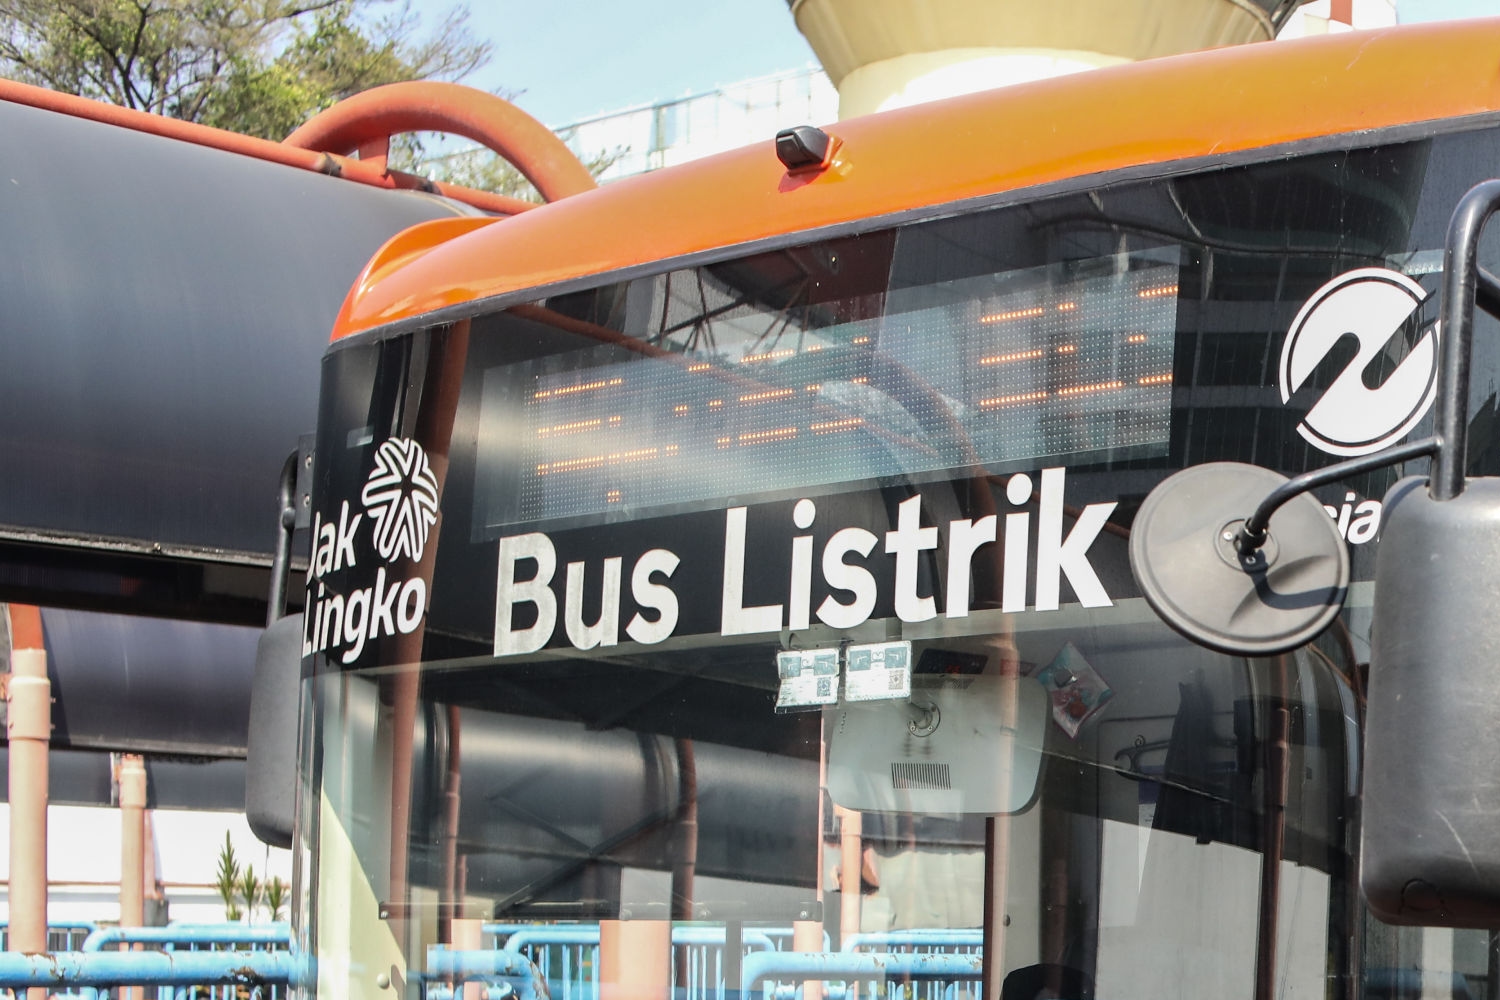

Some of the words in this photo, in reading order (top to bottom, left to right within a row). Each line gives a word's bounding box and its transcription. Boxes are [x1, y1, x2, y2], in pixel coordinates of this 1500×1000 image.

[306, 500, 363, 586] Jak
[493, 532, 681, 658] Bus
[720, 466, 1118, 637] Listrik
[302, 567, 427, 664] Lingko
